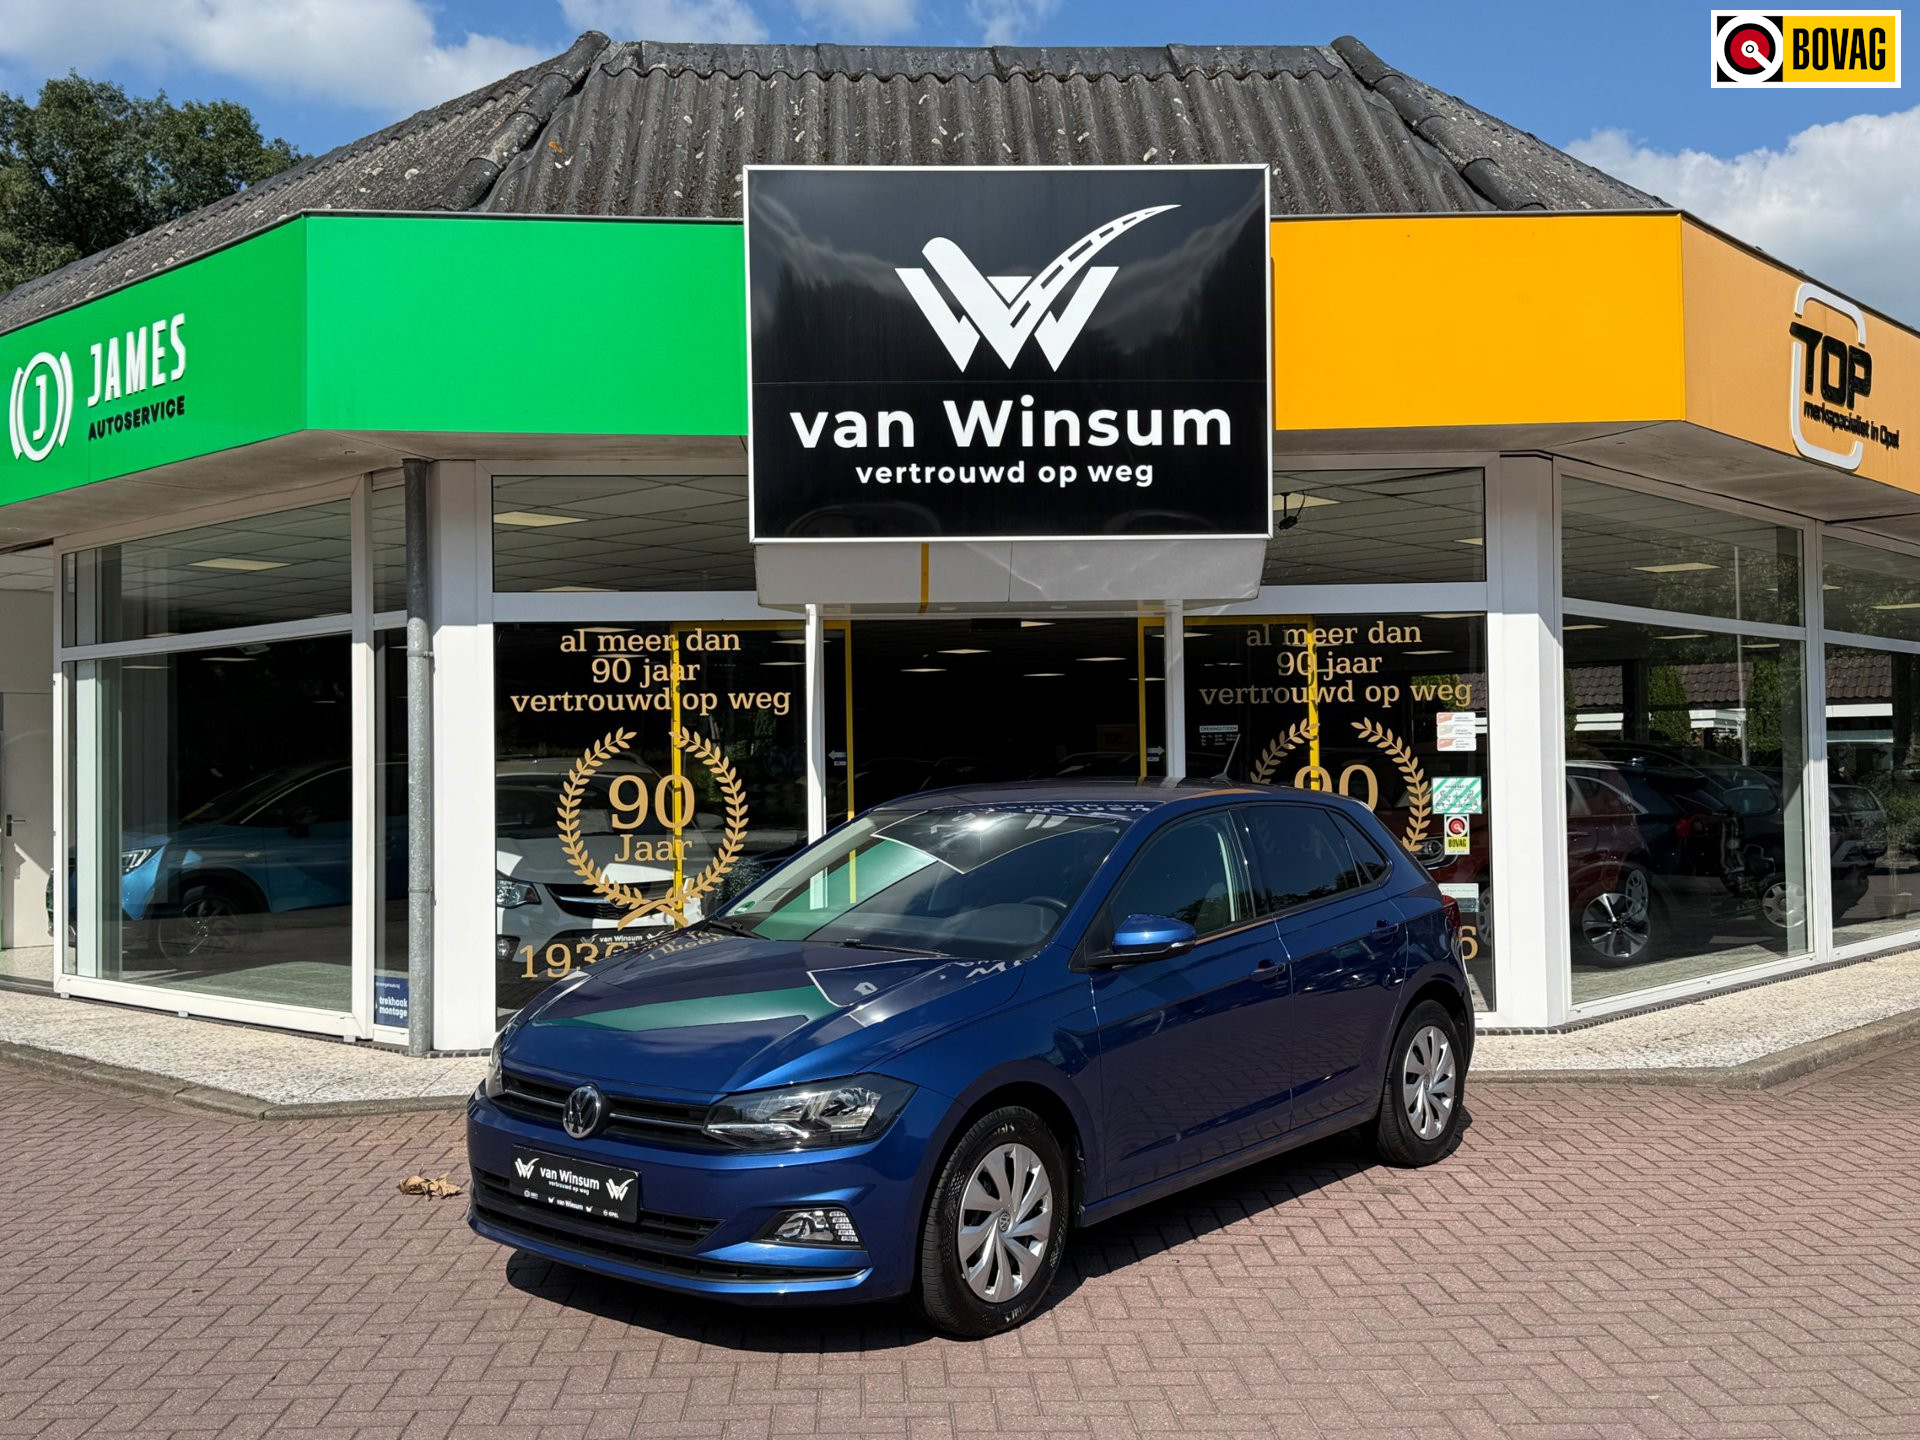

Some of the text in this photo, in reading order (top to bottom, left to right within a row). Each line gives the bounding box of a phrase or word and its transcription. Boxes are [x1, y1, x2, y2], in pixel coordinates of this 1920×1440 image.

[87, 312, 187, 408] JAMES
[1789, 321, 1873, 411] TOP
[88, 395, 186, 442] AUTOSERVICE
[789, 395, 1232, 448] van Winsum
[1871, 421, 1879, 443] in
[1880, 425, 1900, 451] Opel
[855, 461, 1154, 488] vertrouwd op weg
[560, 628, 741, 652] al meer dan
[1246, 620, 1423, 646] al meer dan
[591, 658, 700, 688] 90 jaar
[1277, 651, 1382, 681] 90 jaar
[510, 687, 791, 717] vertrouwd op weg
[1199, 680, 1472, 709] vertrouwd op weg
[608, 775, 696, 830] 90
[614, 834, 692, 863] Jaar
[1448, 838, 1467, 848] BOVAG
[613, 934, 643, 943] Winsum
[540, 1167, 600, 1190] van Winsum
